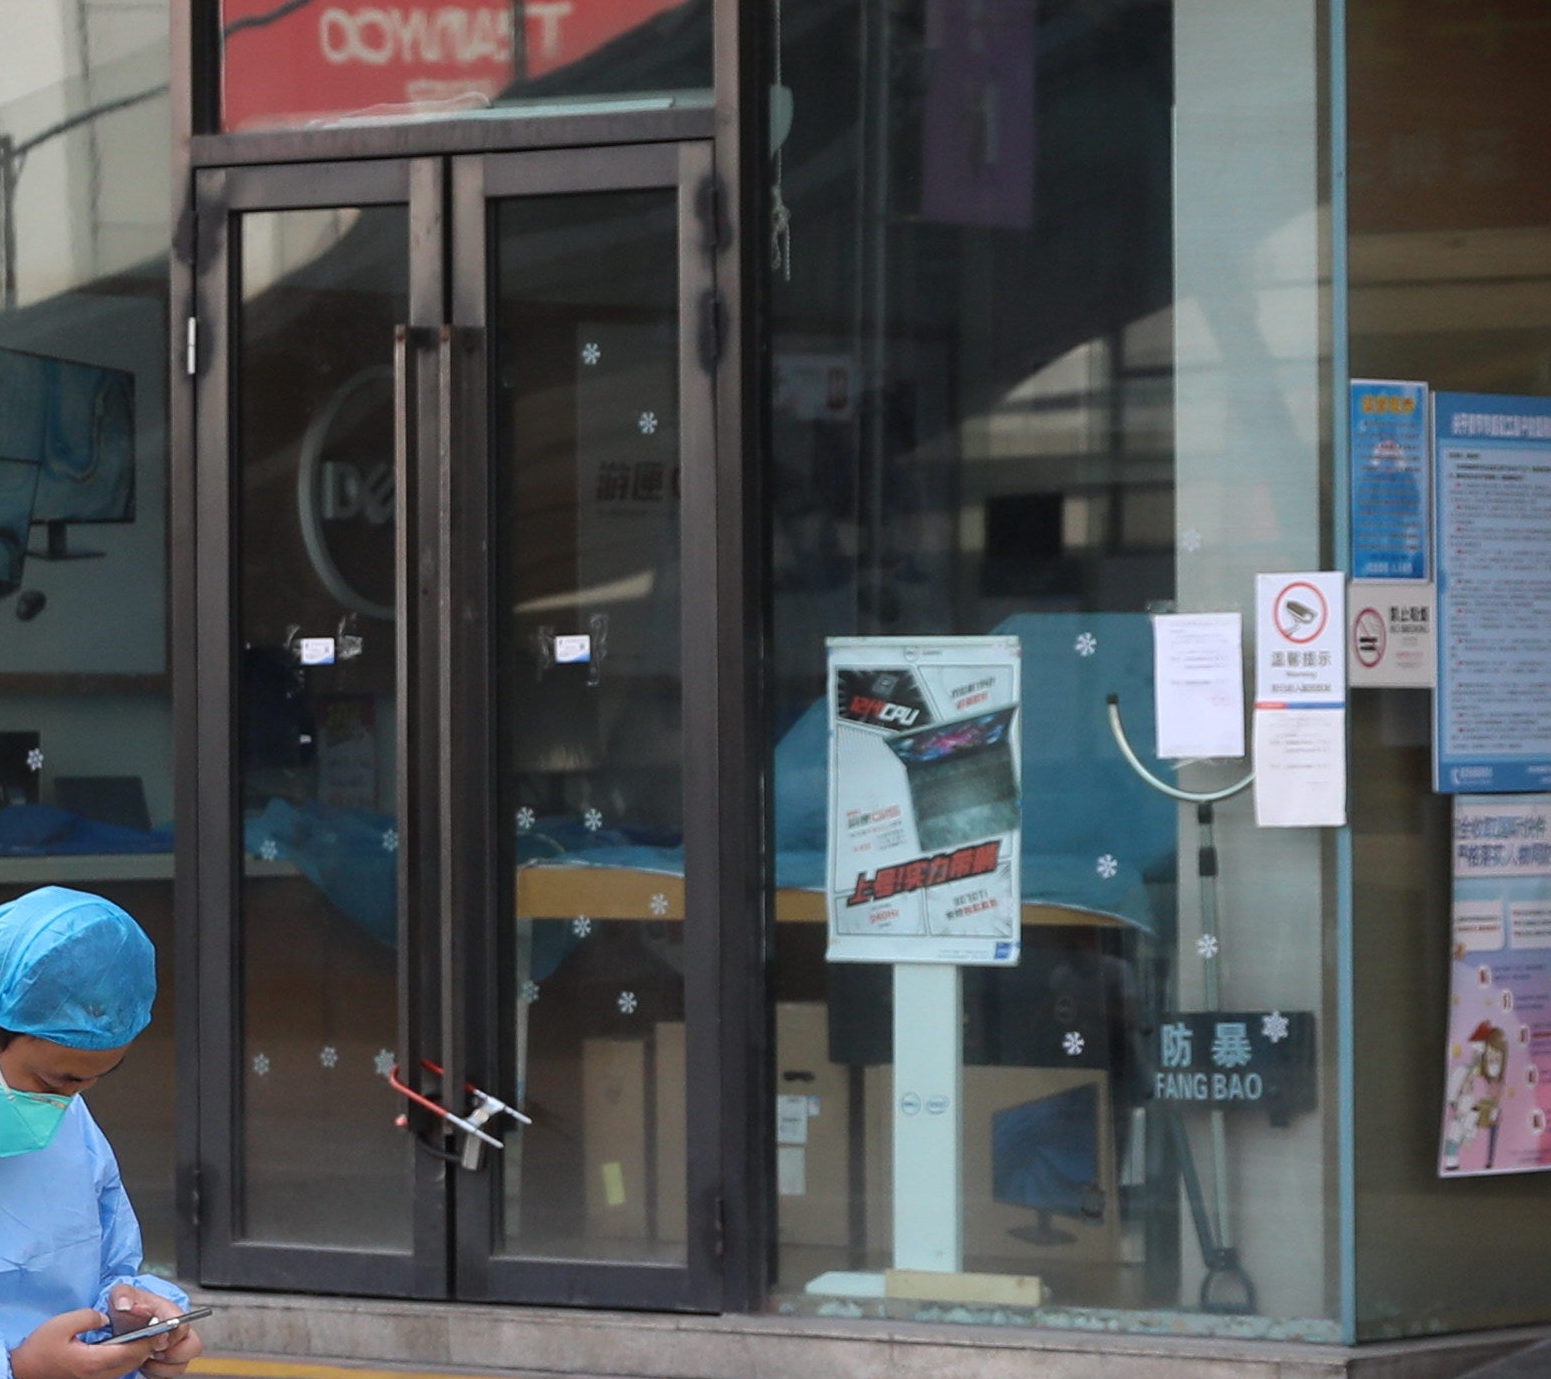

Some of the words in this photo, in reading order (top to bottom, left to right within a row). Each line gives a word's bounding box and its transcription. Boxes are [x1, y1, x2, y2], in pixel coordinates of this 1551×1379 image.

[1270, 650, 1333, 668] 温馨提示
[1159, 1021, 1253, 1069] 防暴
[1155, 1072, 1209, 1101] FANG
[1212, 1072, 1264, 1101] BAO
